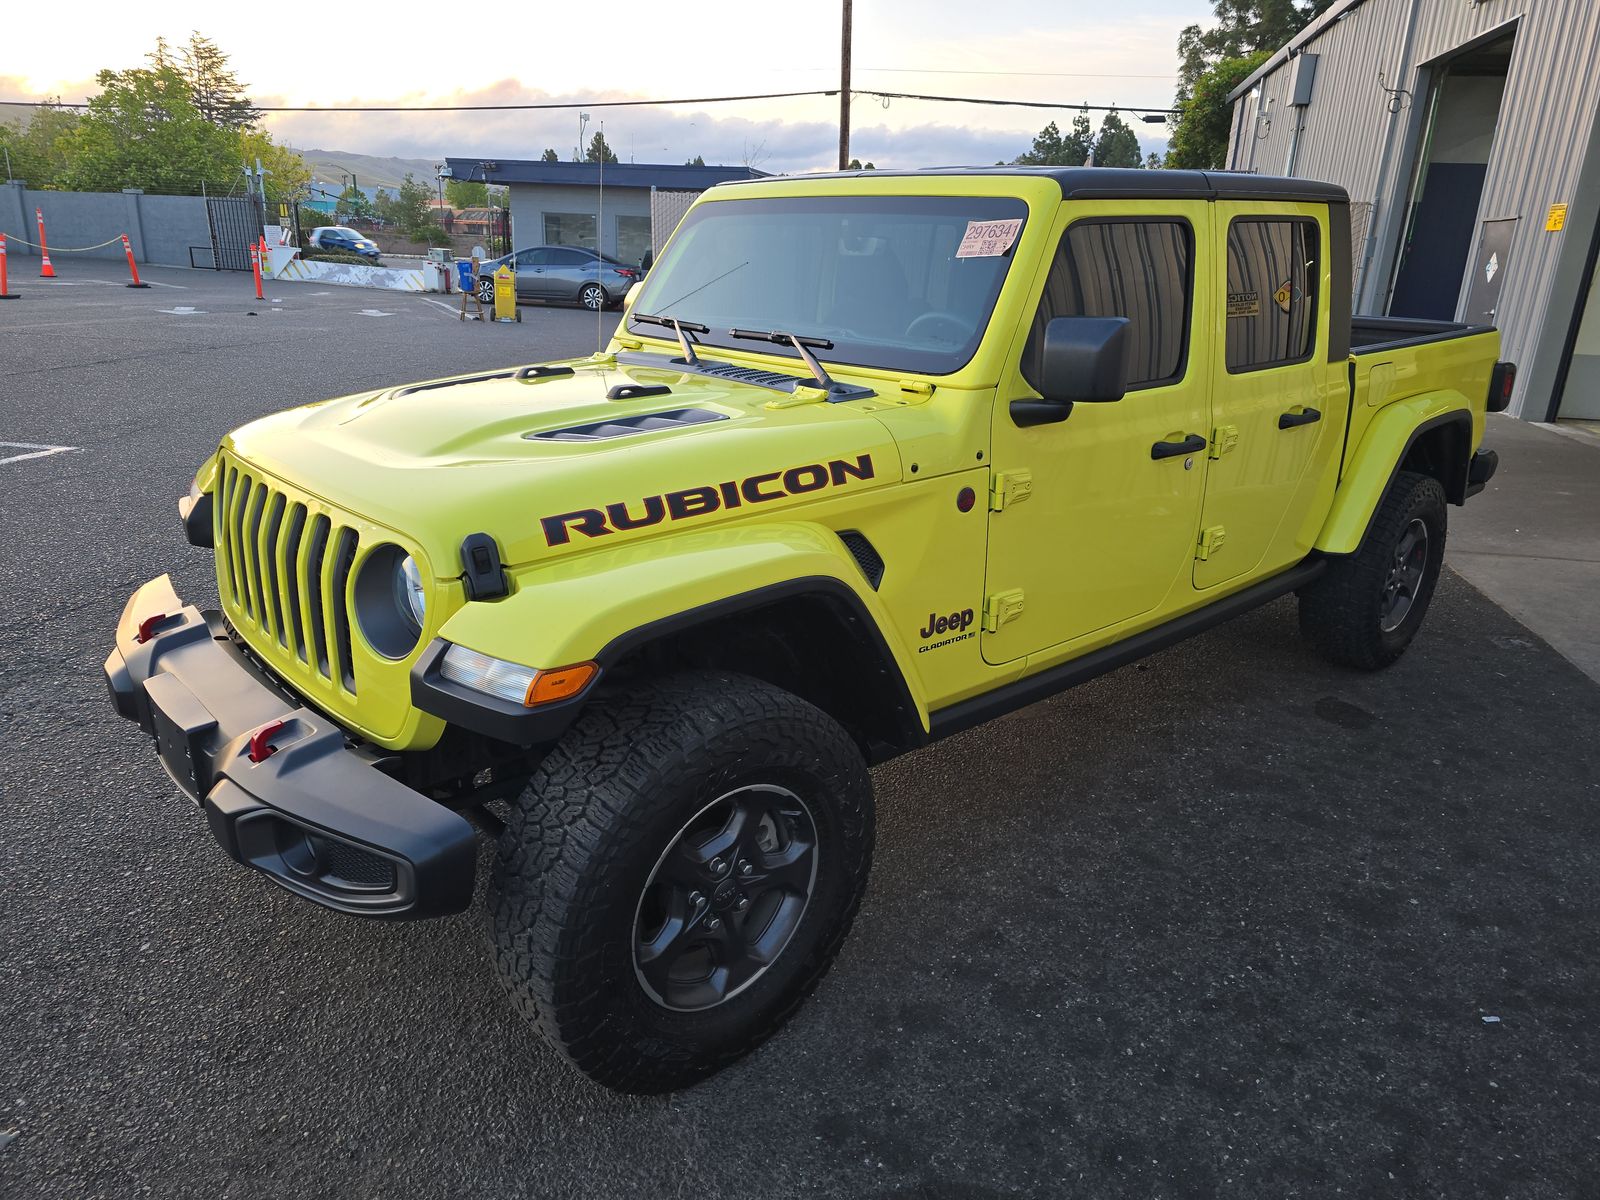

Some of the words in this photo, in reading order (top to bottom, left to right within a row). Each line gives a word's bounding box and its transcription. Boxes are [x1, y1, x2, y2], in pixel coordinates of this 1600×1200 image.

[966, 224, 1019, 239] 2976341
[540, 454, 875, 547] RUBICON
[920, 608, 974, 639] Jeep
[918, 634, 967, 653] GLADIATOR
